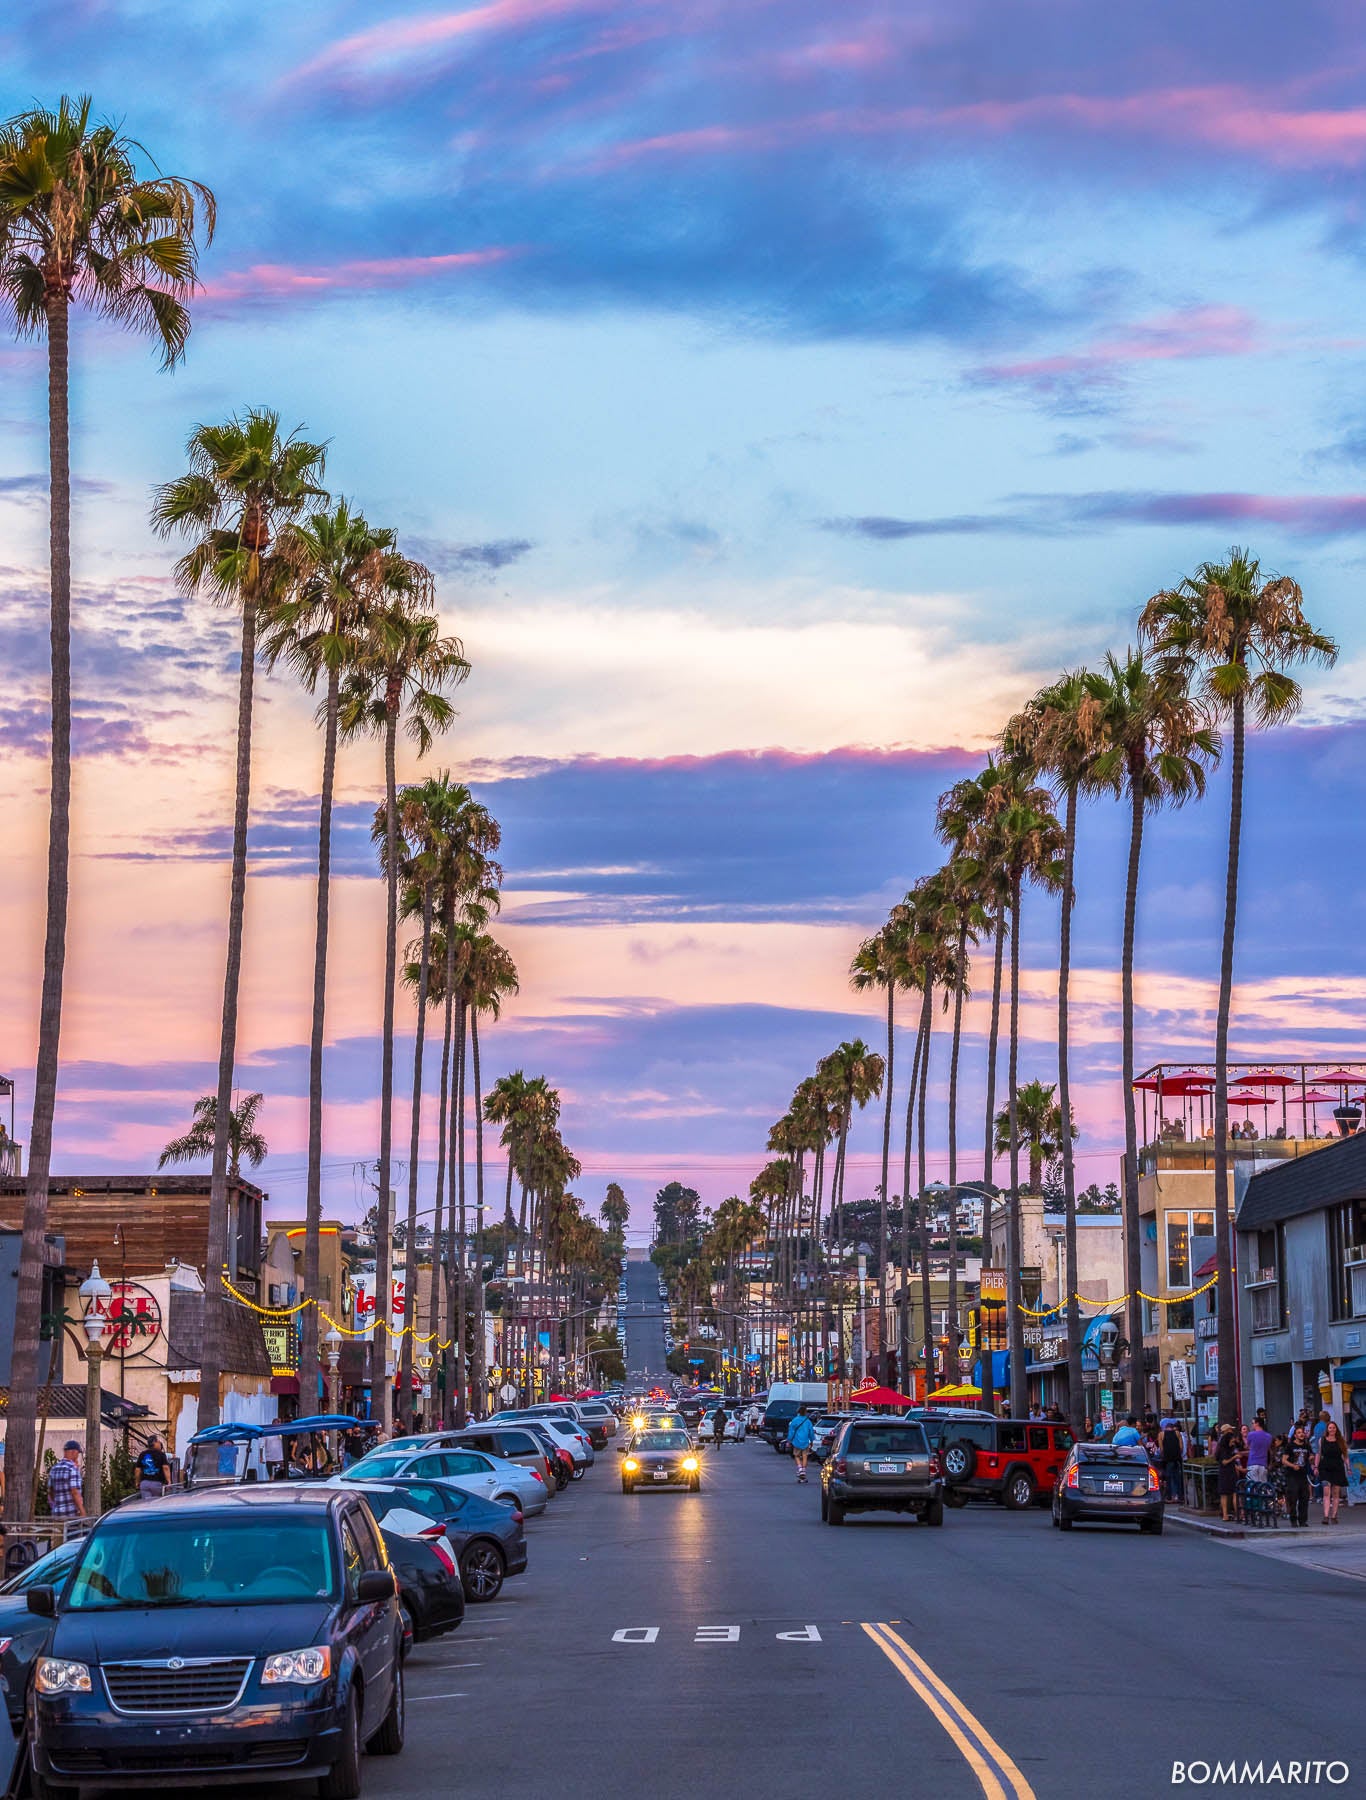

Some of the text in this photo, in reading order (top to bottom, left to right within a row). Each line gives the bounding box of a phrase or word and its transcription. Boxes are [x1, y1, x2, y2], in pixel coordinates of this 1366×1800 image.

[986, 1277, 1004, 1289] PIER
[1023, 1332, 1042, 1345] PIER
[861, 1381, 878, 1390] STOP
